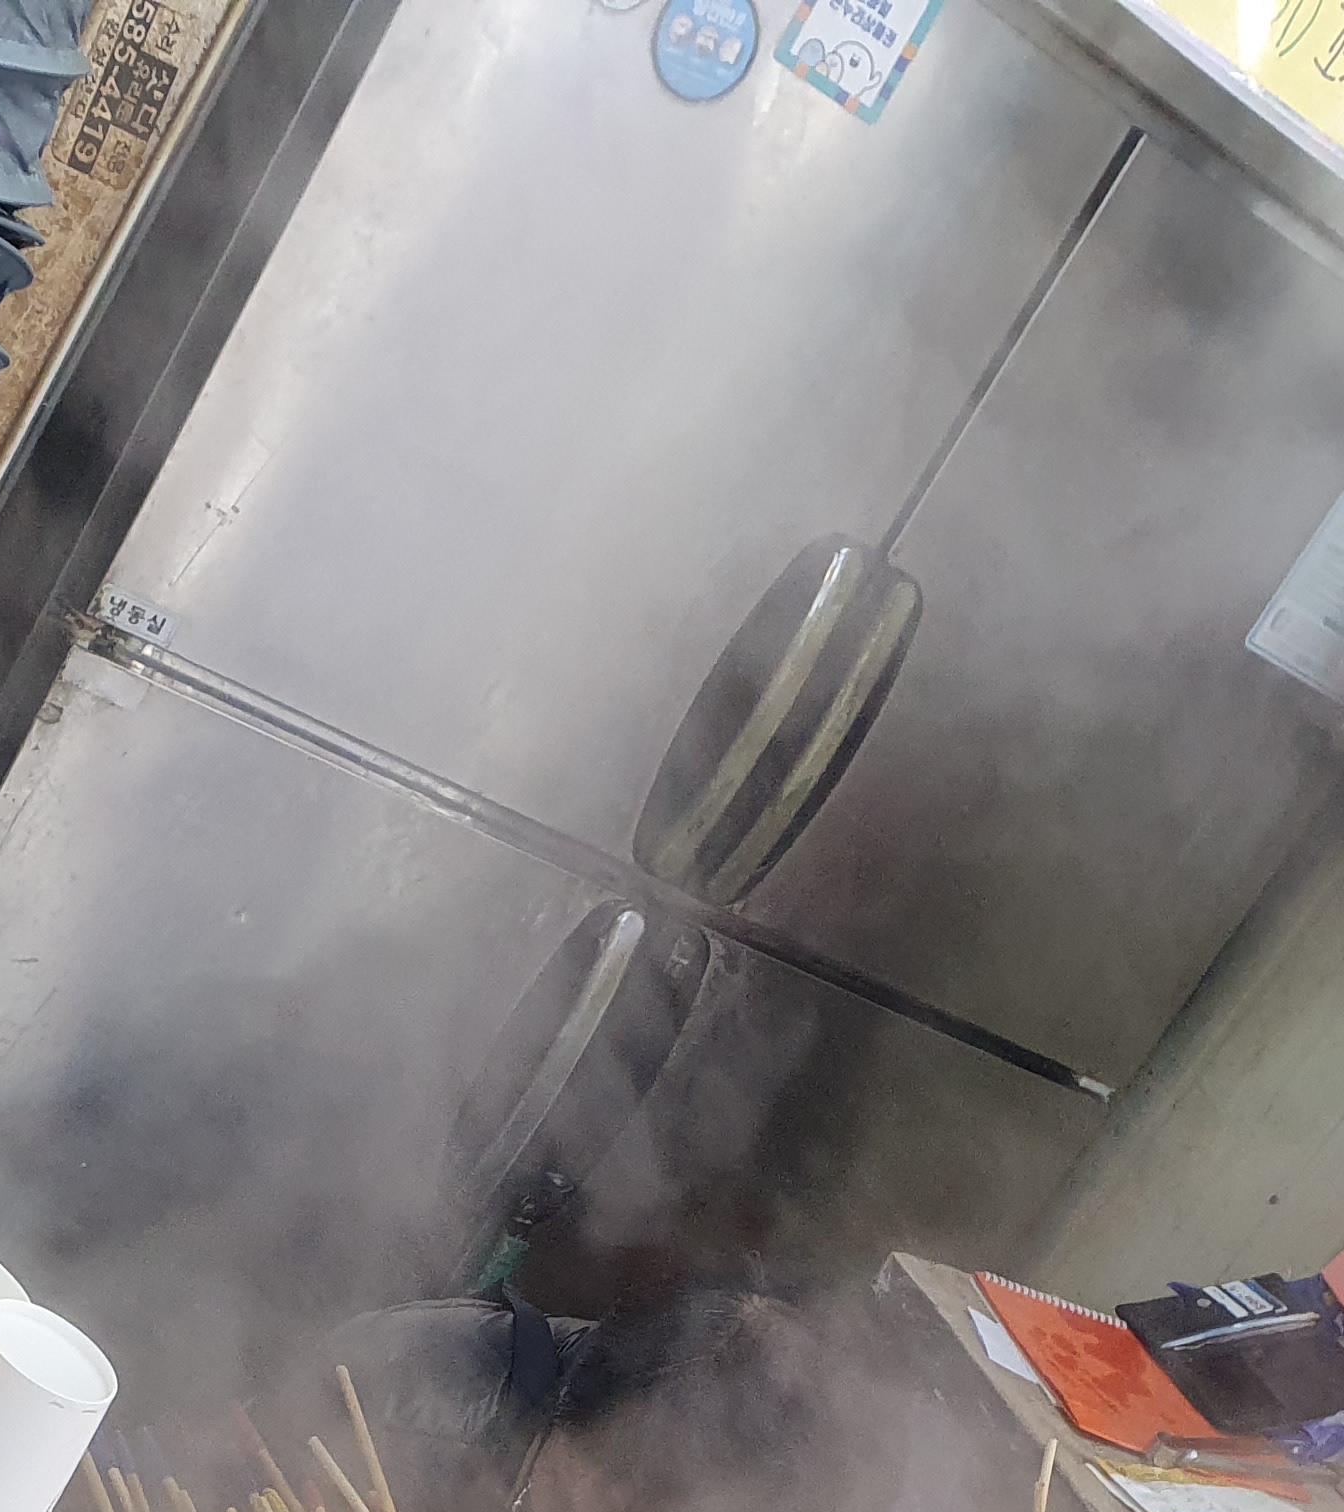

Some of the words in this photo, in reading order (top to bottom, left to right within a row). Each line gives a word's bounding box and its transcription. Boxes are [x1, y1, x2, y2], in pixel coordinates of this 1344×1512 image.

[153, 14, 184, 55] 수리
[69, 0, 156, 166] 585-4419
[108, 595, 166, 635] 냉동실
